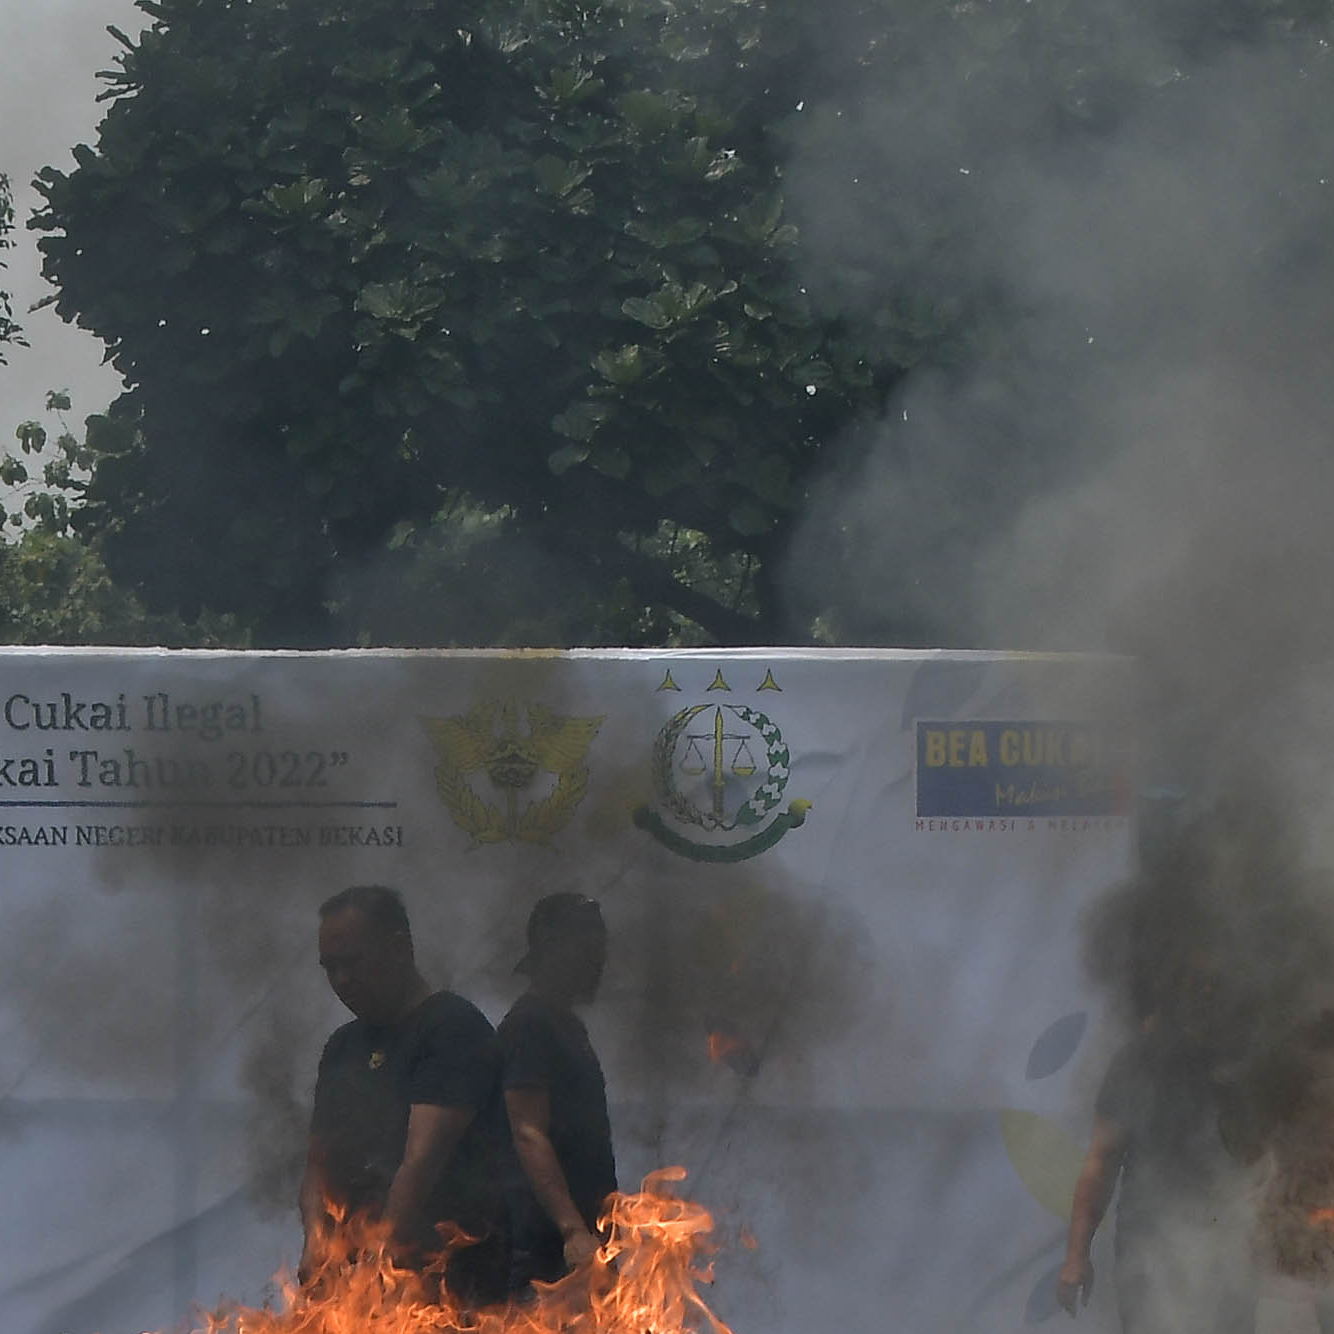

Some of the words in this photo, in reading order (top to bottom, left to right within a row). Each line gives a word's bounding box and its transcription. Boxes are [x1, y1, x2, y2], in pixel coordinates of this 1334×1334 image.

[3, 692, 127, 731] Cukai
[142, 692, 264, 741] Ilegal
[925, 729, 988, 768] BEA
[999, 729, 1098, 767] CUKA
[75, 825, 164, 847] NEGERI
[169, 825, 312, 848] KABUPATEN
[318, 825, 404, 848] BEKASI
[915, 819, 1016, 832] MENGAWASI
